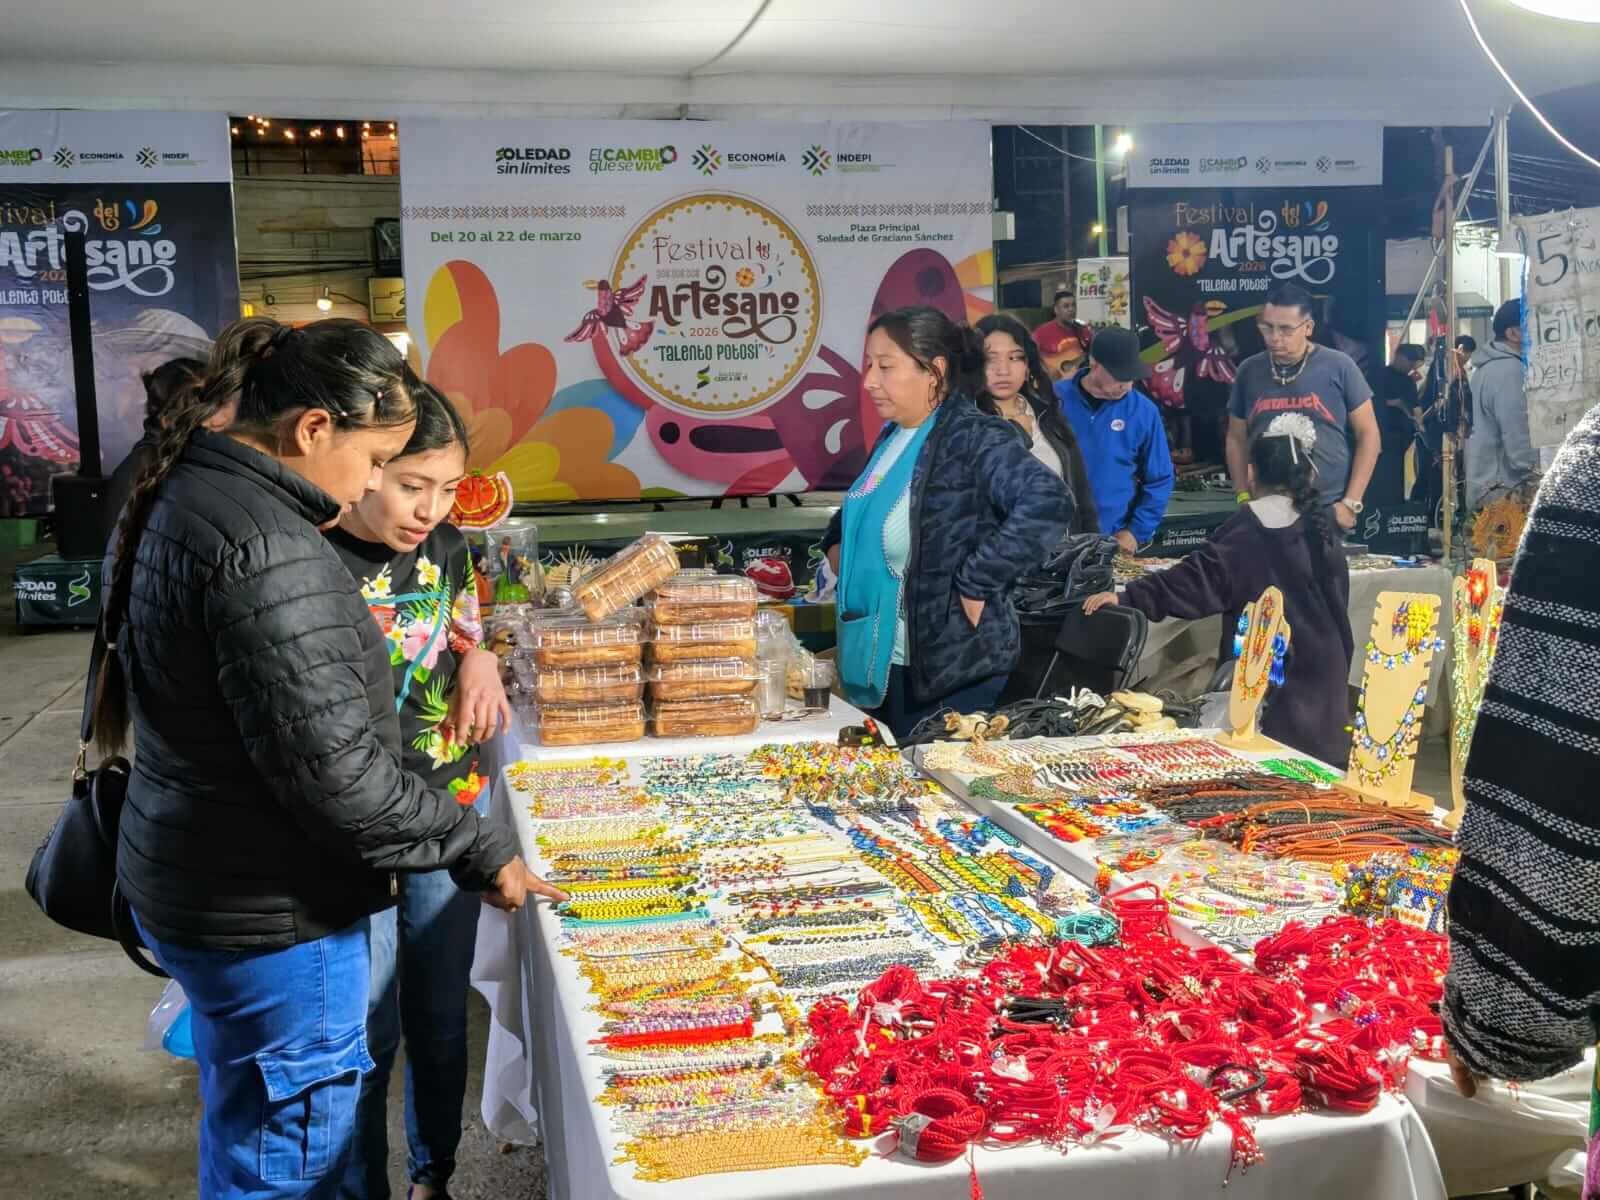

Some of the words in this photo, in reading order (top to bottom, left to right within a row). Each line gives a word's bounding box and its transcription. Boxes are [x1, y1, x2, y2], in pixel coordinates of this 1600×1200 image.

[603, 145, 677, 164] CAMBIO
[727, 151, 786, 162] ECONOMÍA
[837, 152, 872, 162] INDEPI
[497, 162, 518, 175] sin
[589, 161, 616, 174] que
[617, 162, 634, 172] se
[635, 160, 664, 172] vive
[94, 198, 120, 231] del
[1175, 201, 1254, 227] Festival
[850, 223, 876, 232] Plaza
[879, 223, 920, 233] Principal
[431, 231, 453, 242] Del
[458, 231, 476, 242] 20
[480, 230, 492, 241] al
[497, 231, 515, 241] 22
[520, 230, 535, 241] de
[539, 232, 581, 241] marzo
[817, 234, 855, 243] Soledad
[857, 234, 869, 242] de
[871, 233, 912, 242] Graciano
[915, 232, 954, 241] Sánchez
[0, 210, 177, 296] Artsano
[652, 236, 752, 264] Festival
[1209, 209, 1339, 284] Artesano
[1534, 233, 1569, 287] 5
[40, 271, 67, 282] 202
[650, 265, 800, 344] Artesano
[689, 327, 719, 337] 2026
